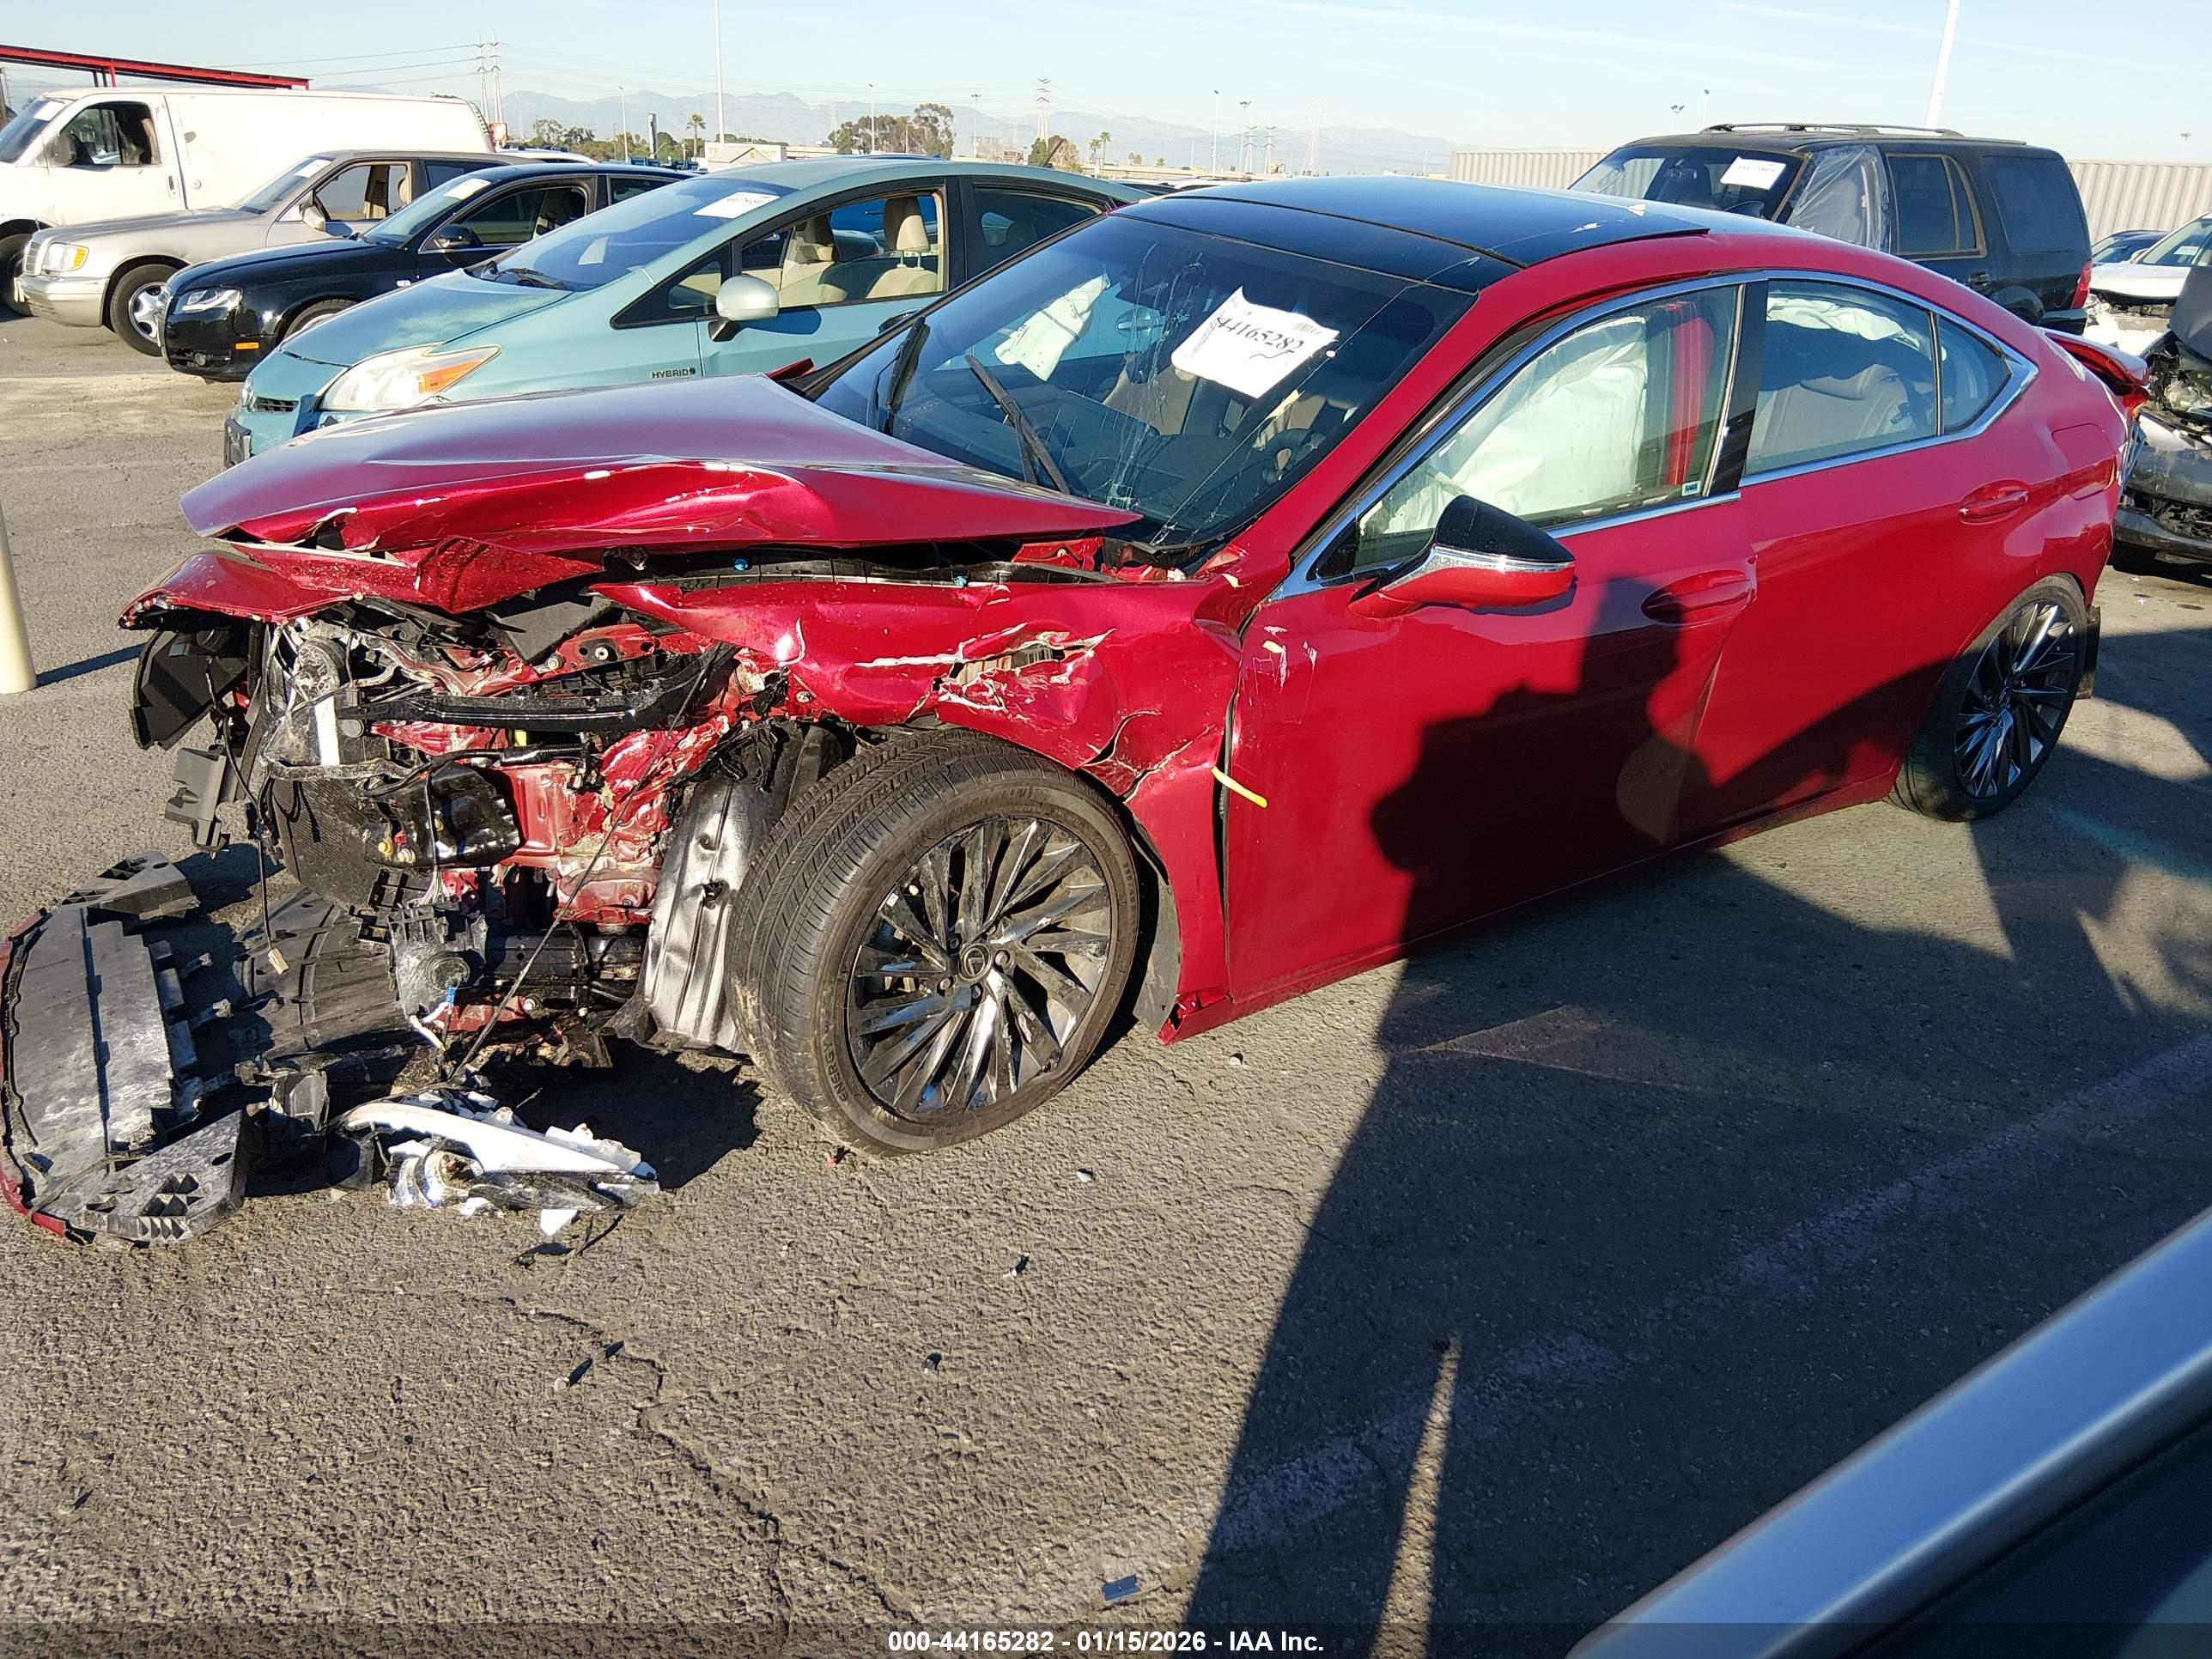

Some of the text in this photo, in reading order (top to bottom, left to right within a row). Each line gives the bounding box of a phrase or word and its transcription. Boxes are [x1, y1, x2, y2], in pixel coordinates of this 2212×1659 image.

[1215, 315, 1304, 355] 44165282
[652, 368, 690, 379] HYBRID
[822, 1038, 849, 1103] ENERGY
